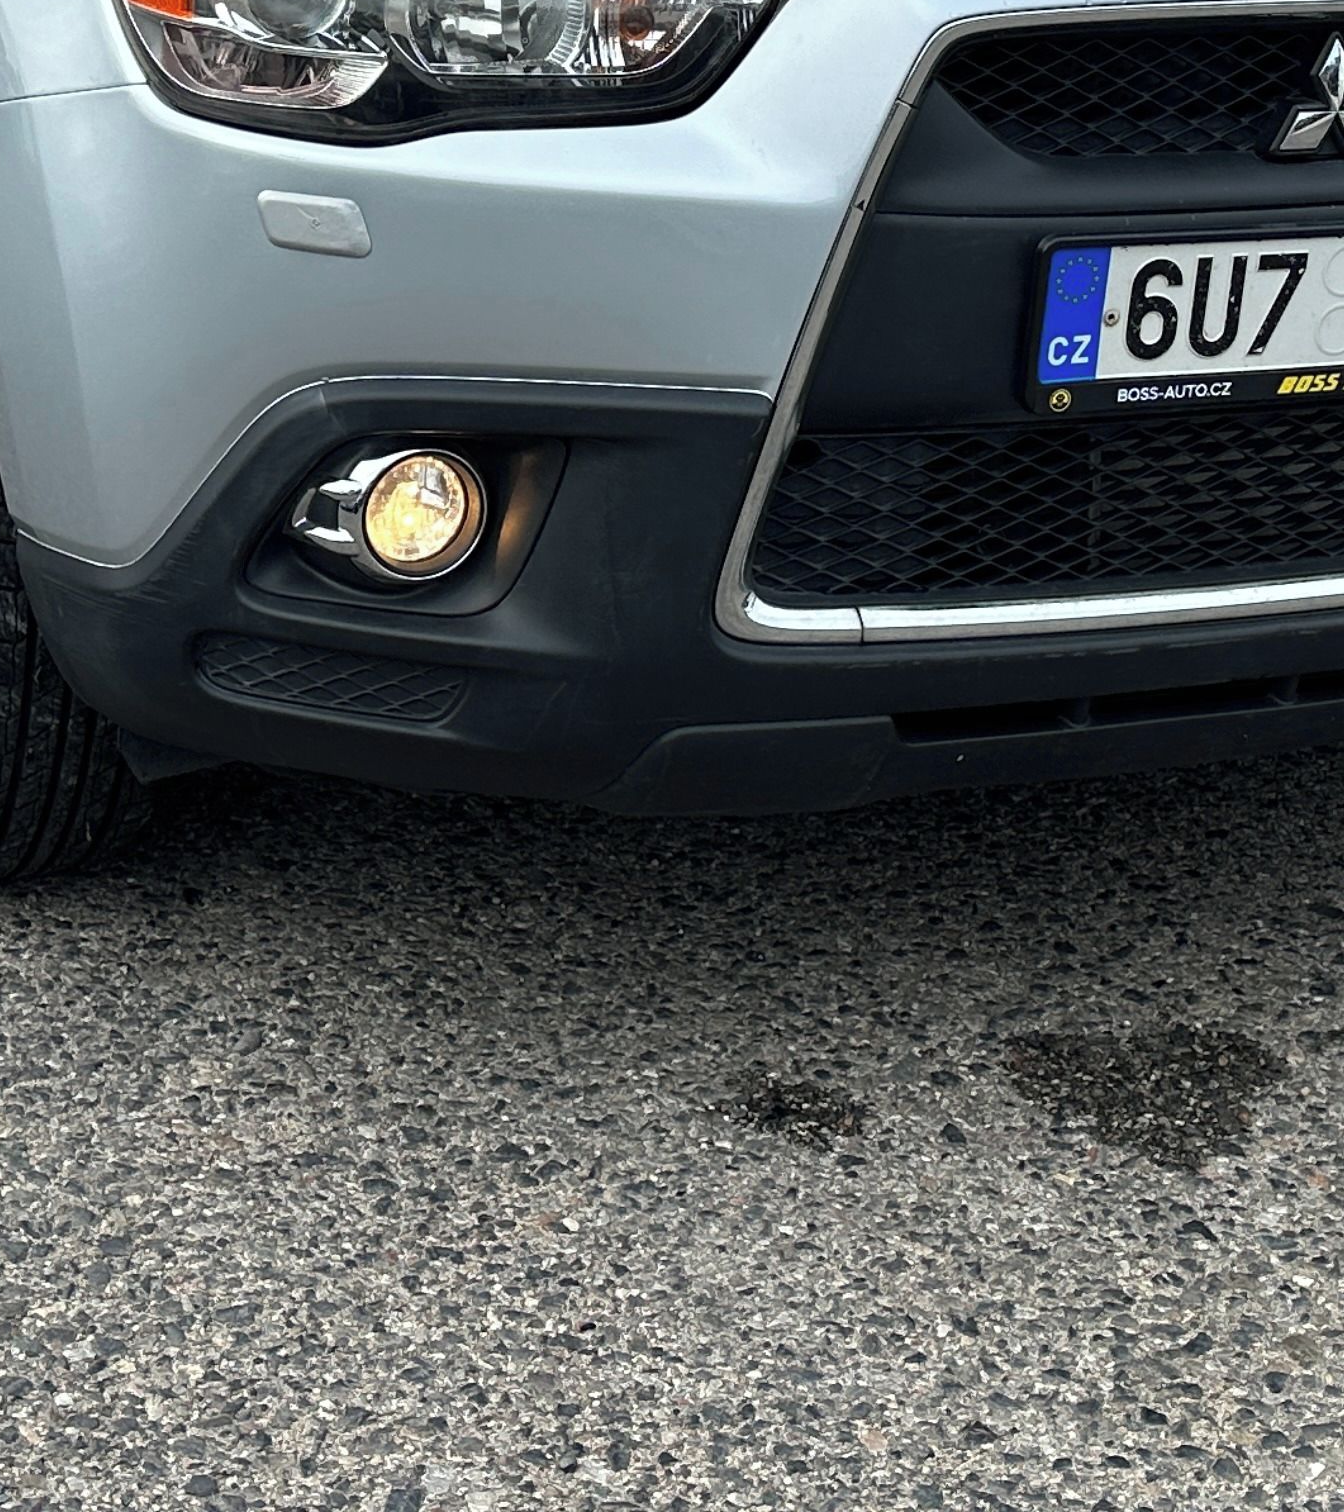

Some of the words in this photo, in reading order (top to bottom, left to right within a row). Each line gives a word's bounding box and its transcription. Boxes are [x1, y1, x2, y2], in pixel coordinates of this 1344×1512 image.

[1126, 252, 1309, 361] 6U7
[1046, 334, 1092, 367] CZ
[1116, 381, 1233, 403] BOSS-AUTO.CZ
[1276, 373, 1341, 395] BOSS
